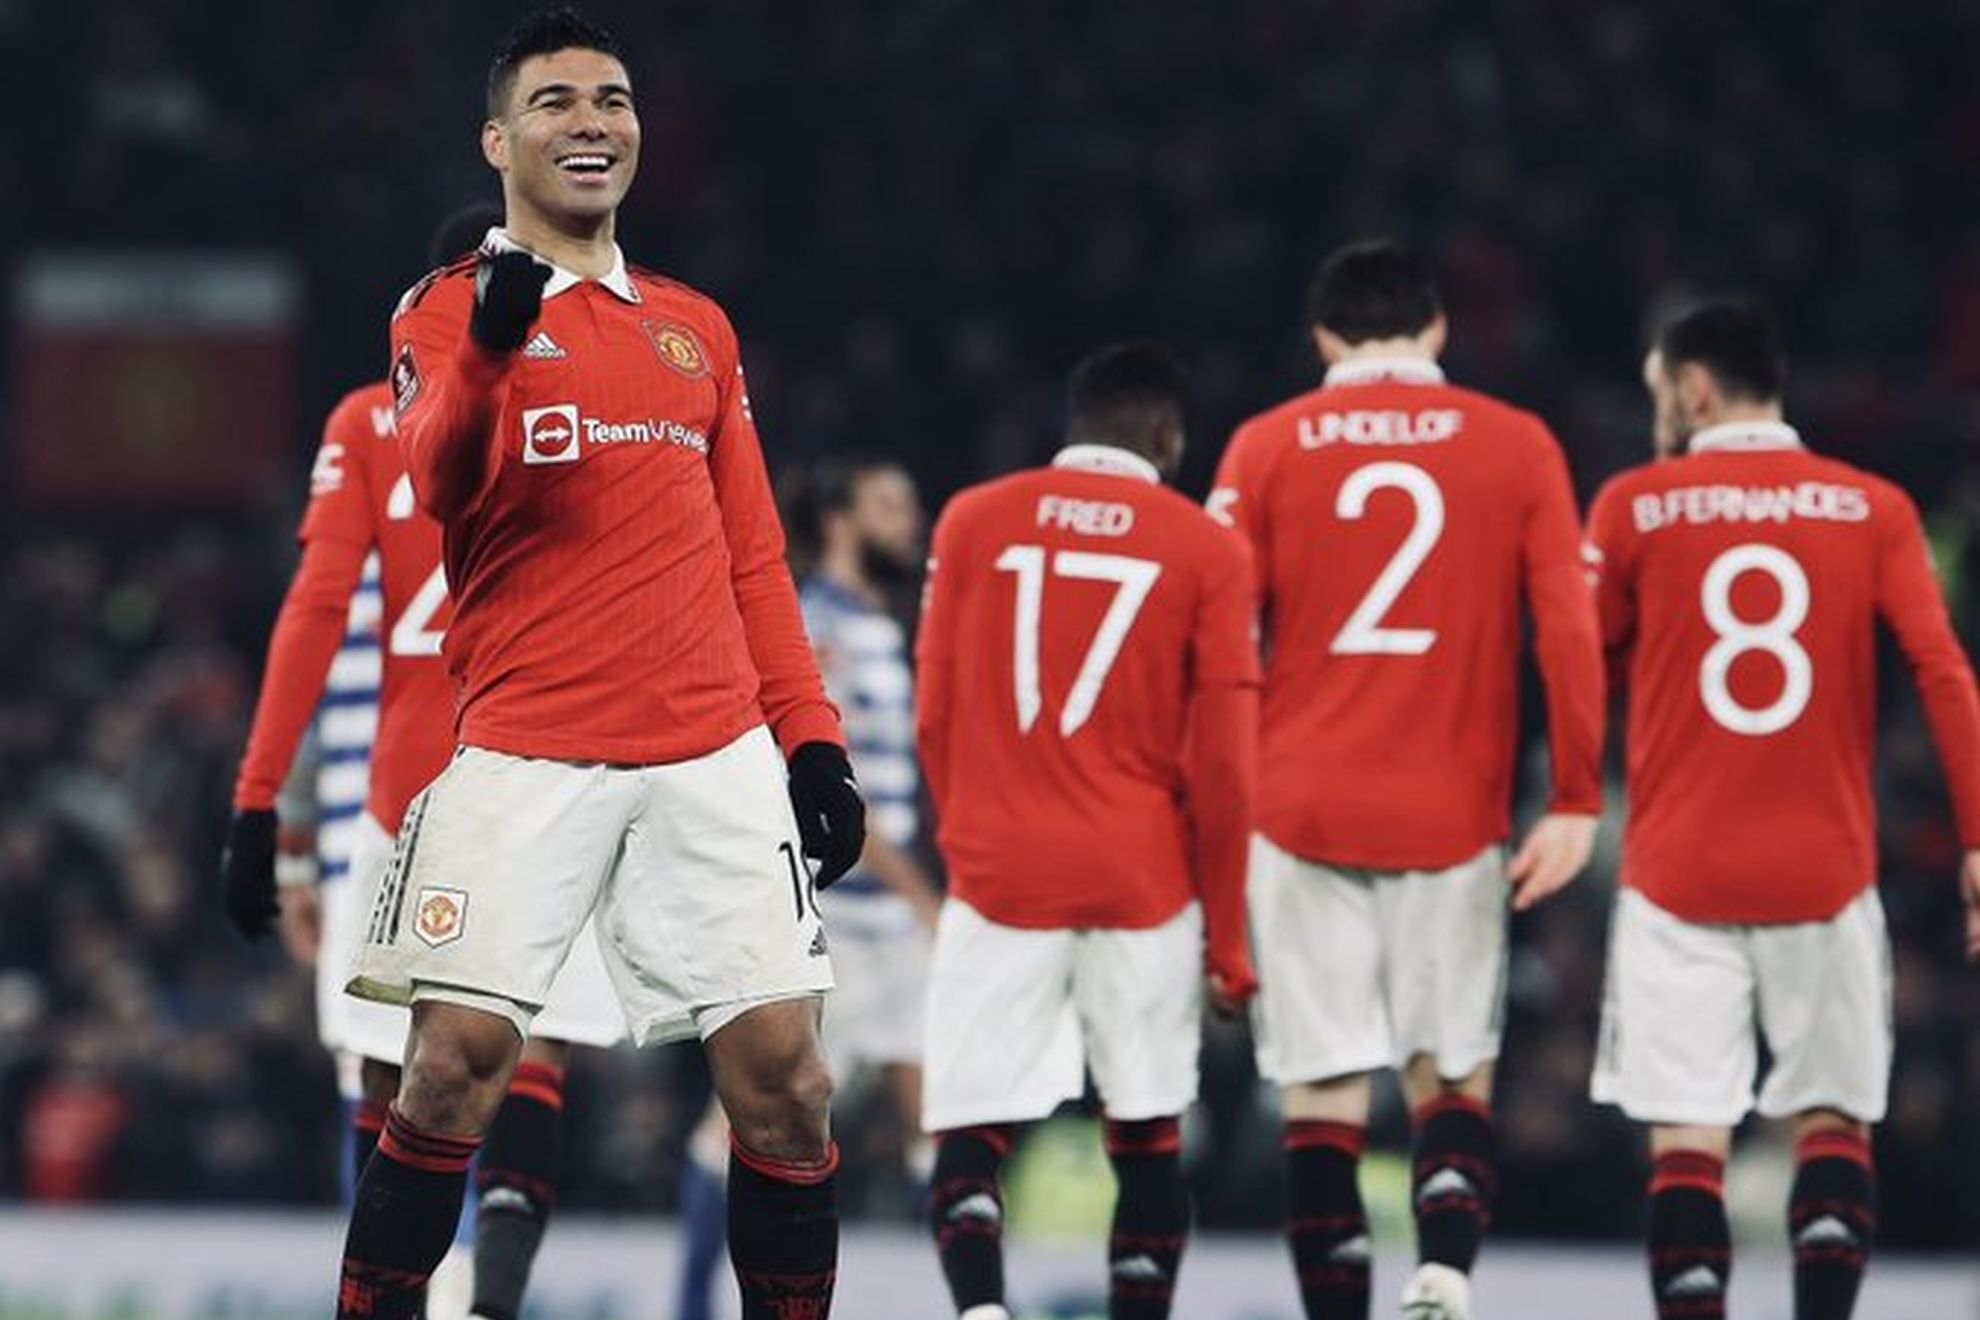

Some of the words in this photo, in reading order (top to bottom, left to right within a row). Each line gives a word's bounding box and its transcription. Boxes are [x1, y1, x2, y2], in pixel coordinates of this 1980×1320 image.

[1037, 494, 1134, 536] FRED
[1330, 461, 1445, 656] 2
[994, 545, 1162, 738] 17
[1699, 542, 1813, 736] 8
